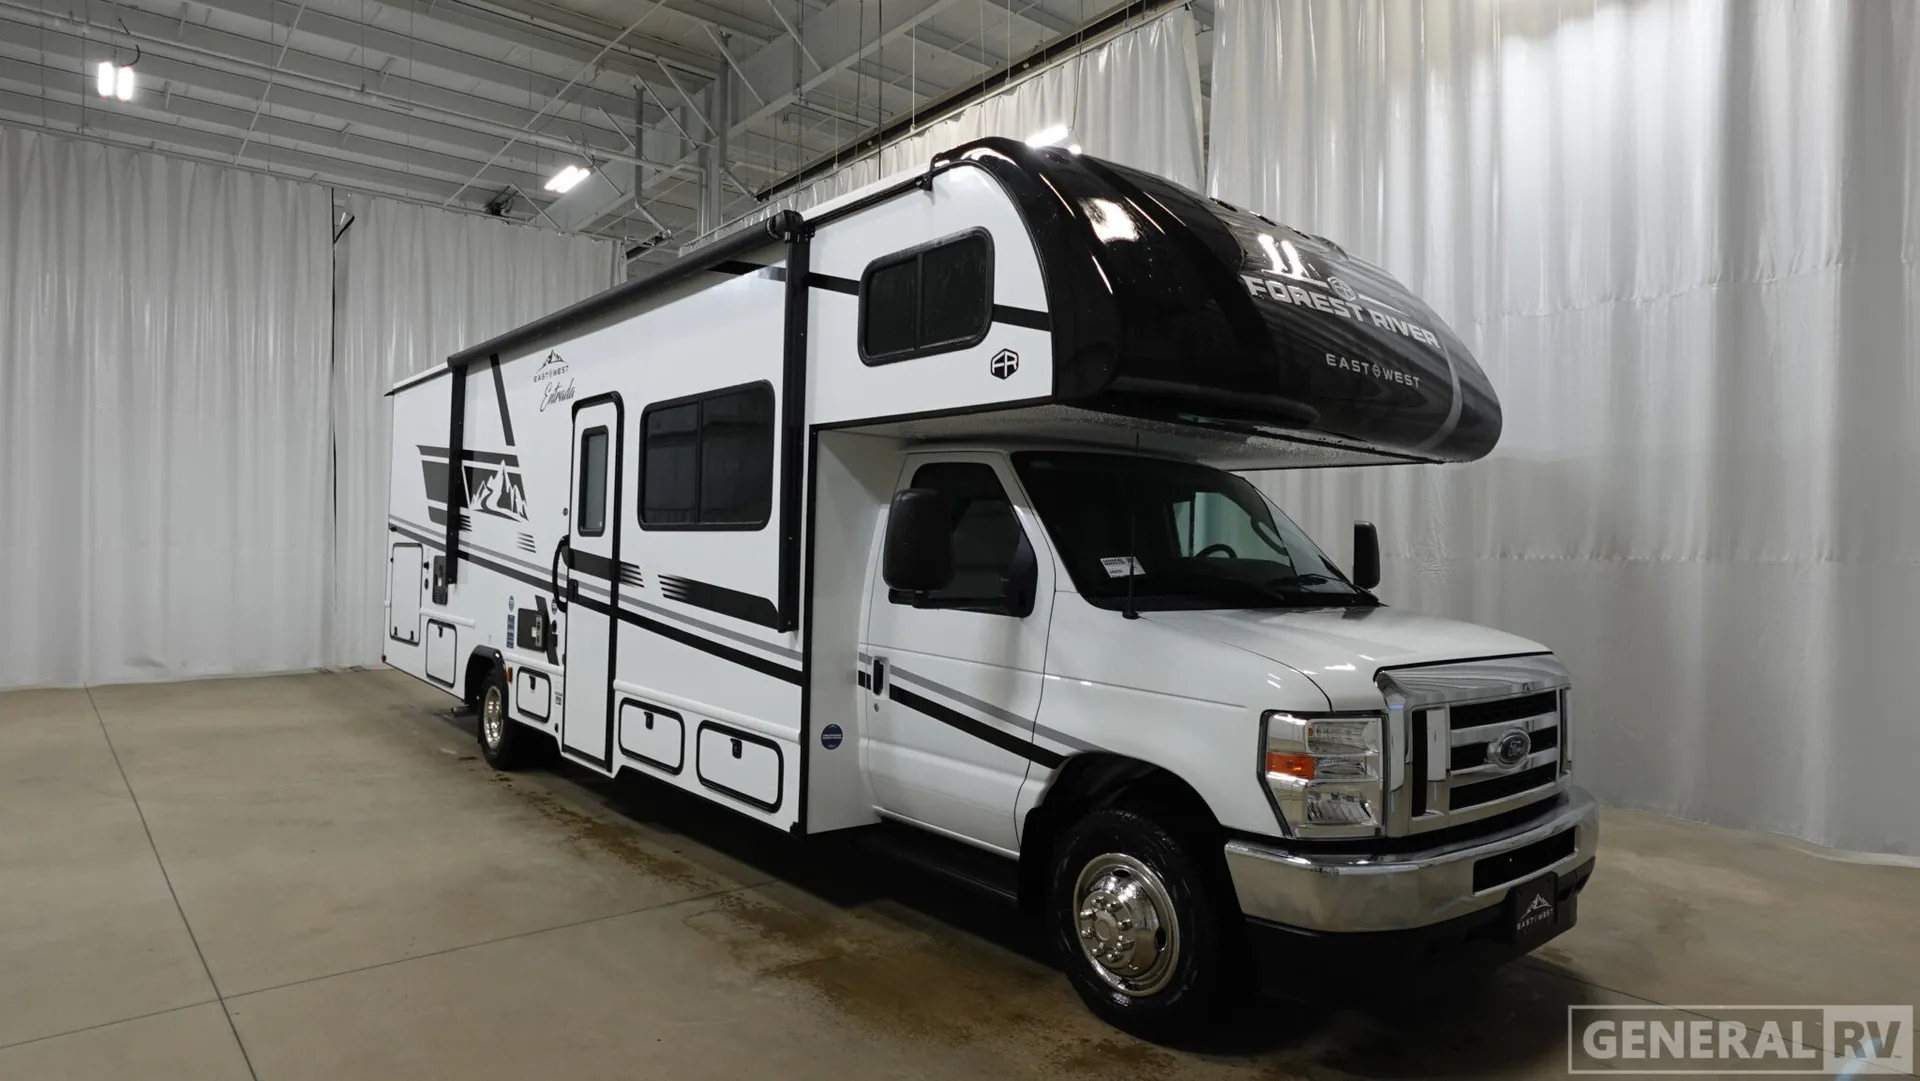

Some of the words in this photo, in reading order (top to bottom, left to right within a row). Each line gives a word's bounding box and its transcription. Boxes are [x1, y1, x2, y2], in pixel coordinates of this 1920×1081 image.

[1241, 275, 1370, 323] FOREST
[1371, 309, 1441, 349] RIVER
[1326, 353, 1370, 375] EAST
[1382, 367, 1420, 389] WEST
[540, 376, 576, 412] Entrada
